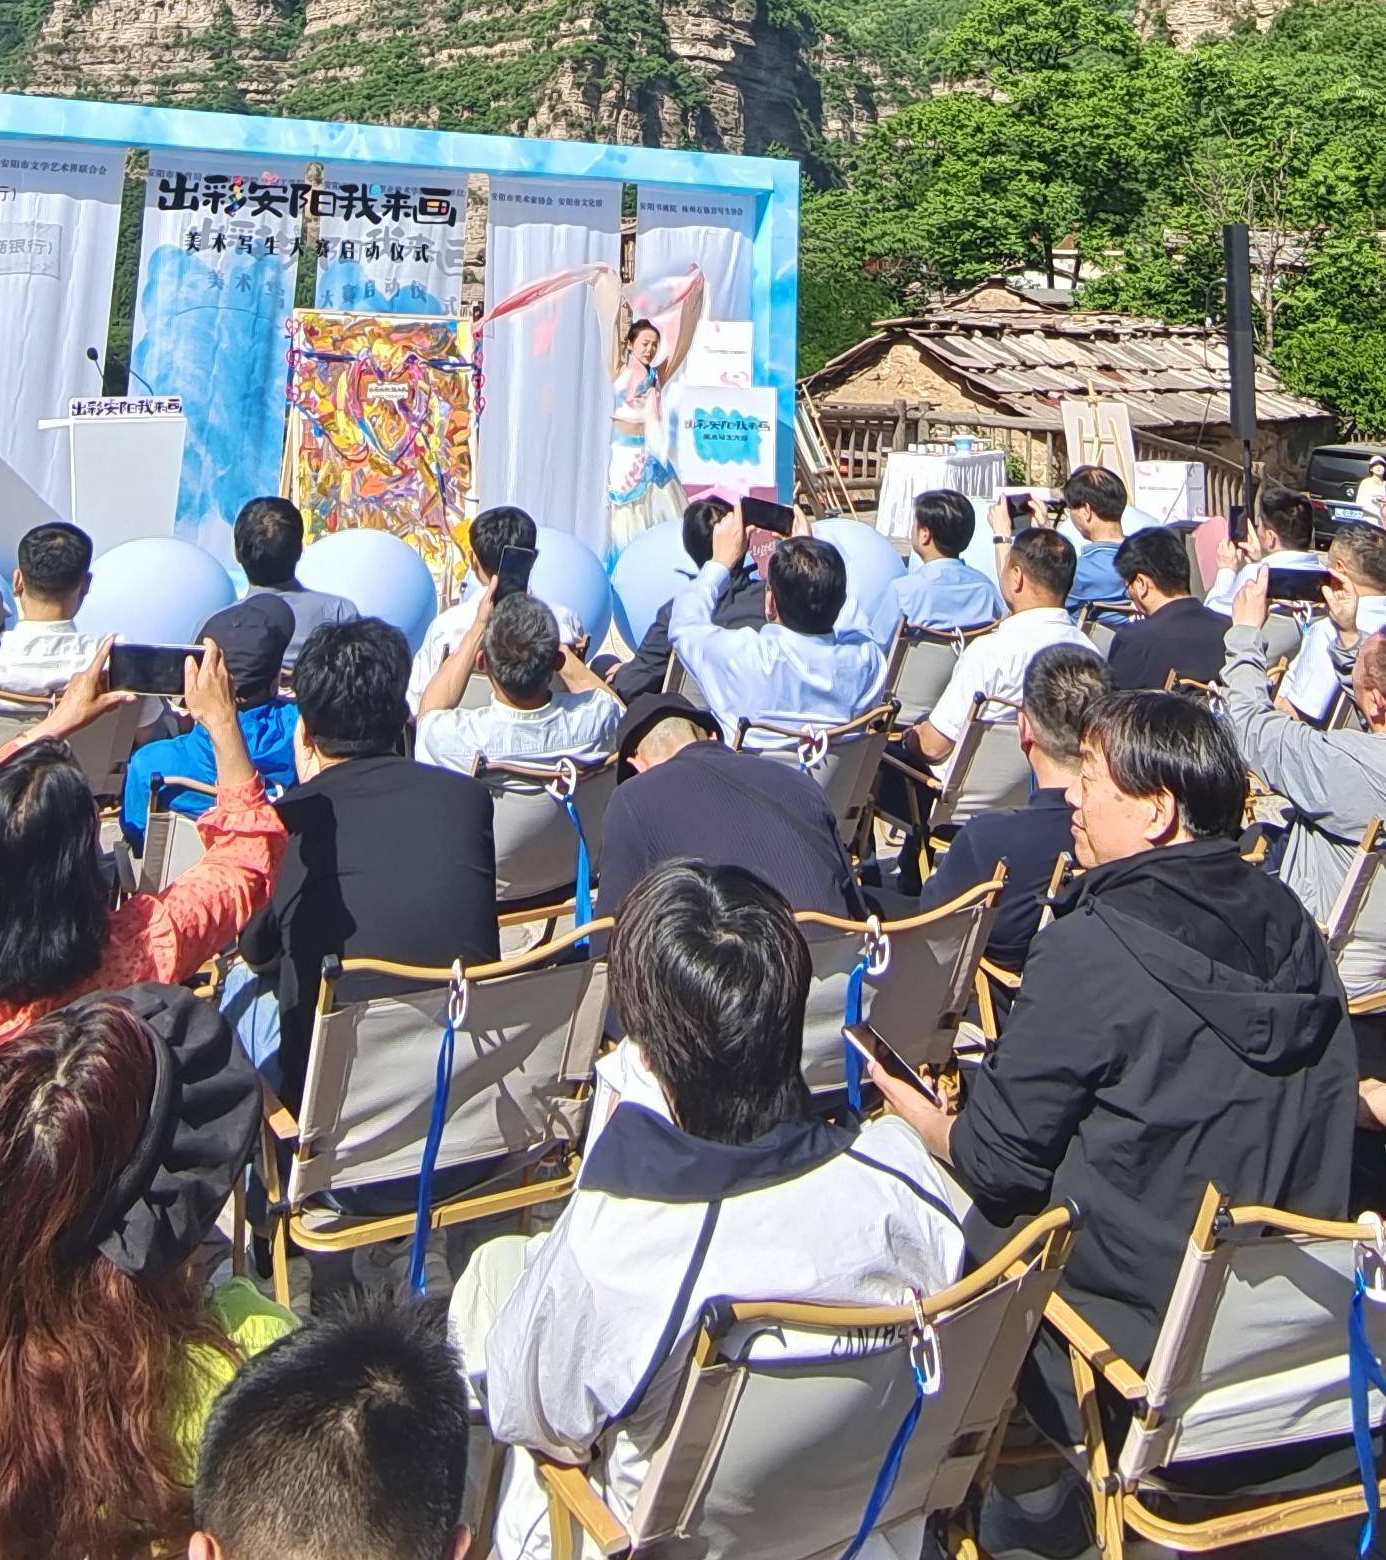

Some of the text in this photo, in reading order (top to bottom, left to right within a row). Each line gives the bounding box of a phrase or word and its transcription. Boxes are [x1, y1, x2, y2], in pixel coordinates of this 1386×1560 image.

[158, 173, 457, 227] 出彩安阳我来画
[183, 231, 430, 264] 美术写生大赛启动仪式
[71, 399, 182, 416] 出彩安阳我来画
